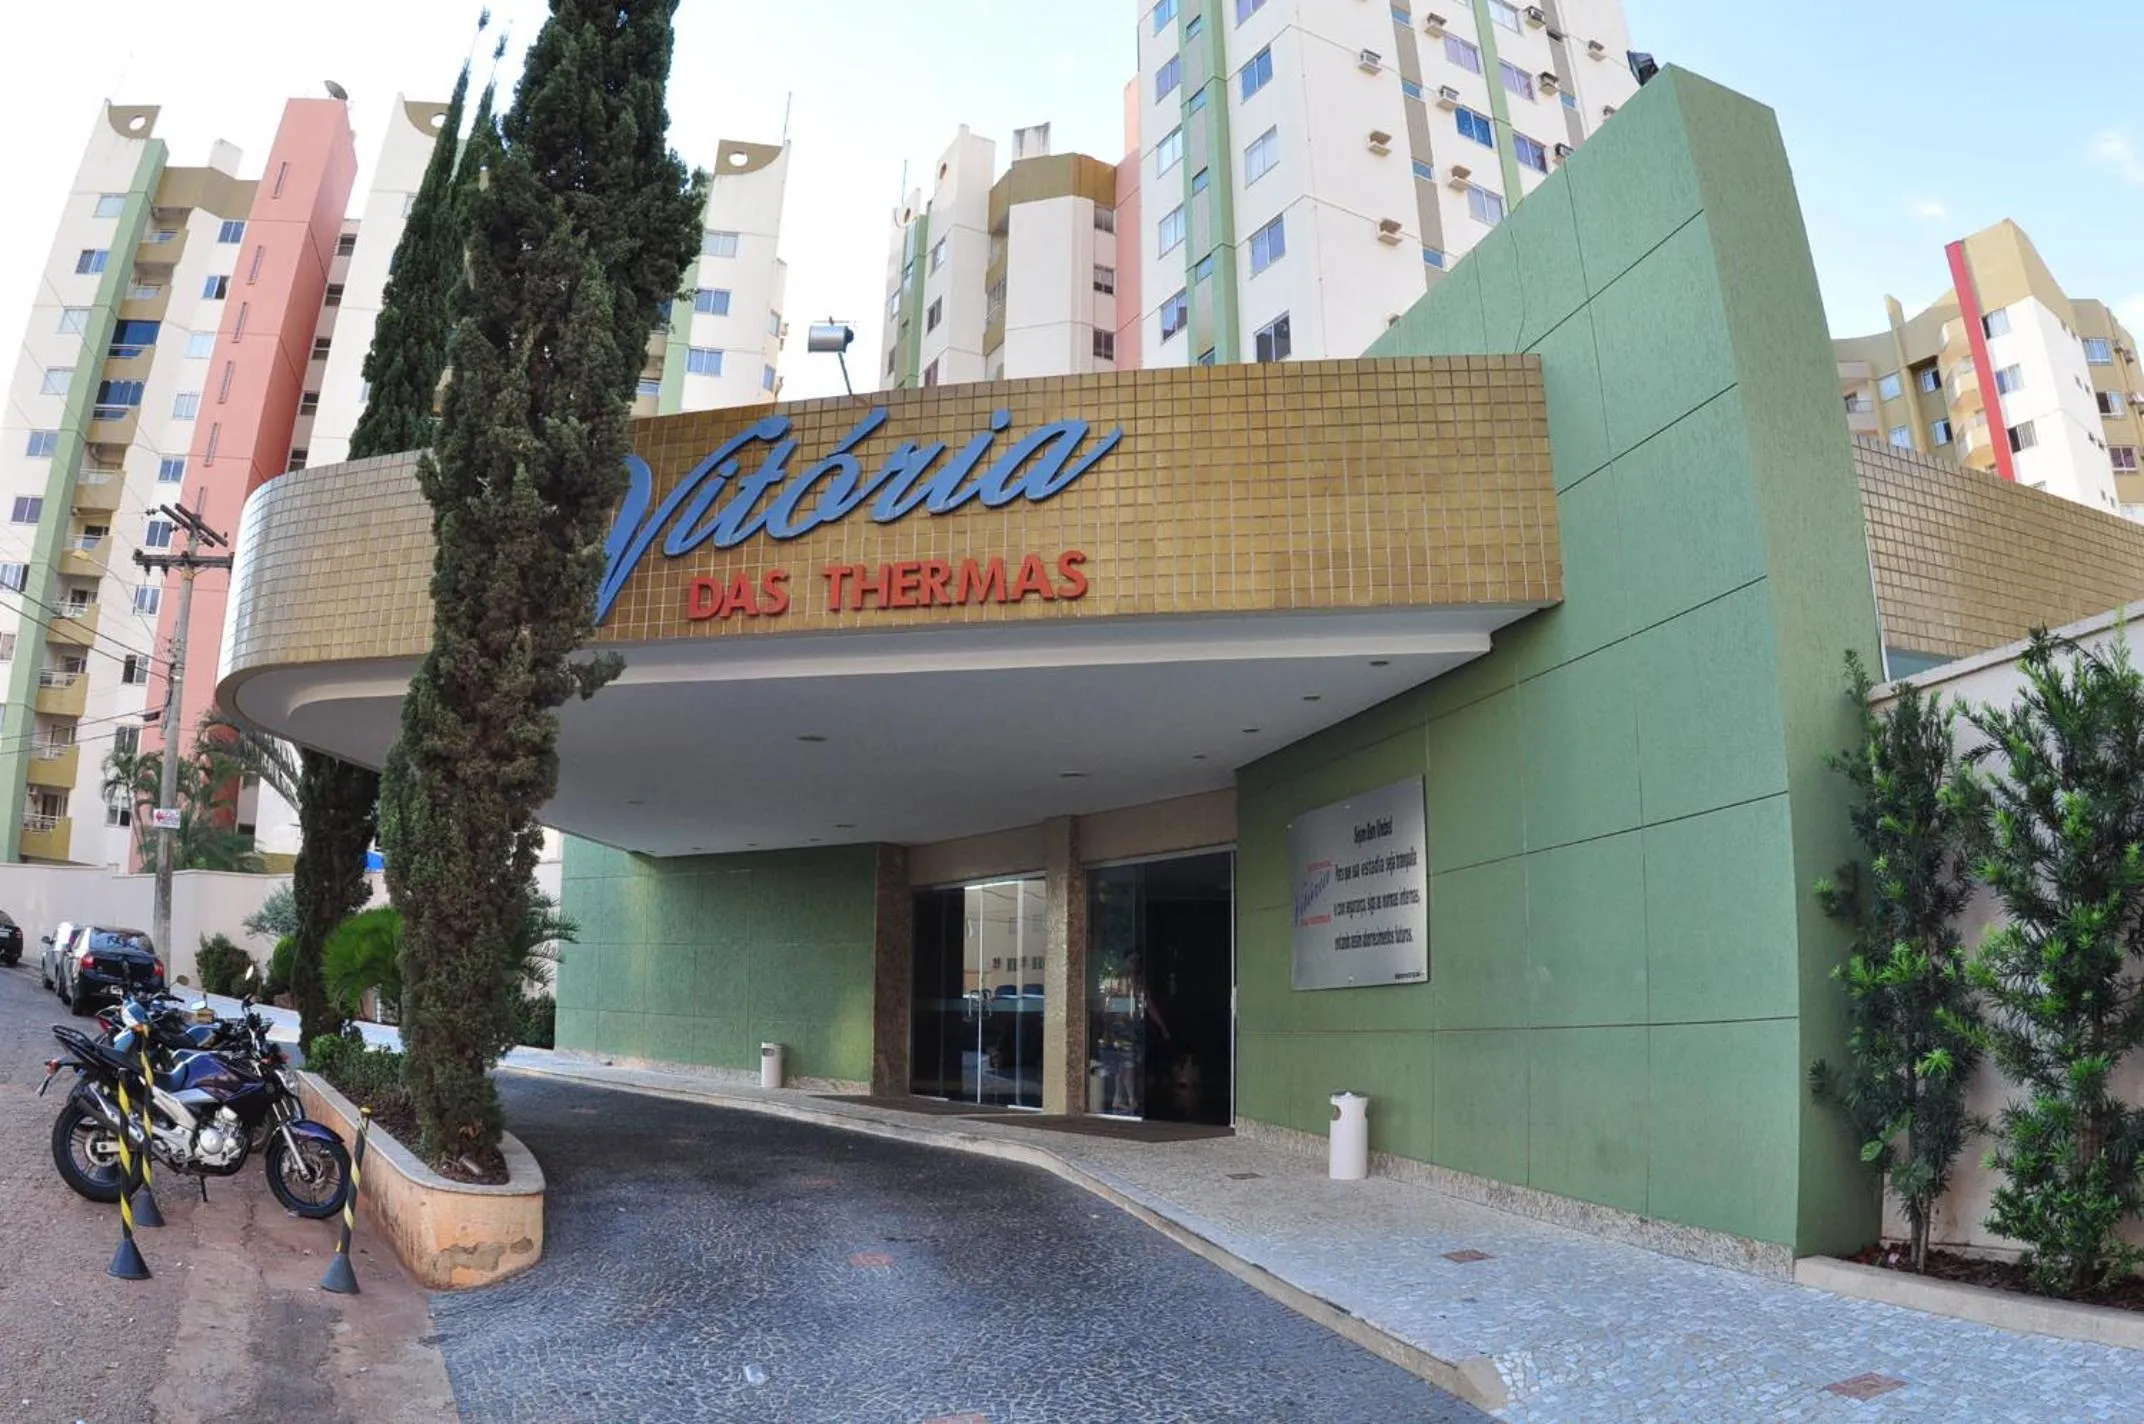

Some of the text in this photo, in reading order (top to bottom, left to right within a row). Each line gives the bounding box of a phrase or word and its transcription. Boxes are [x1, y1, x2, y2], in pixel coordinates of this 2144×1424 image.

[596, 407, 1122, 625] Vitória
[687, 550, 1088, 620] DAS THERMAS
